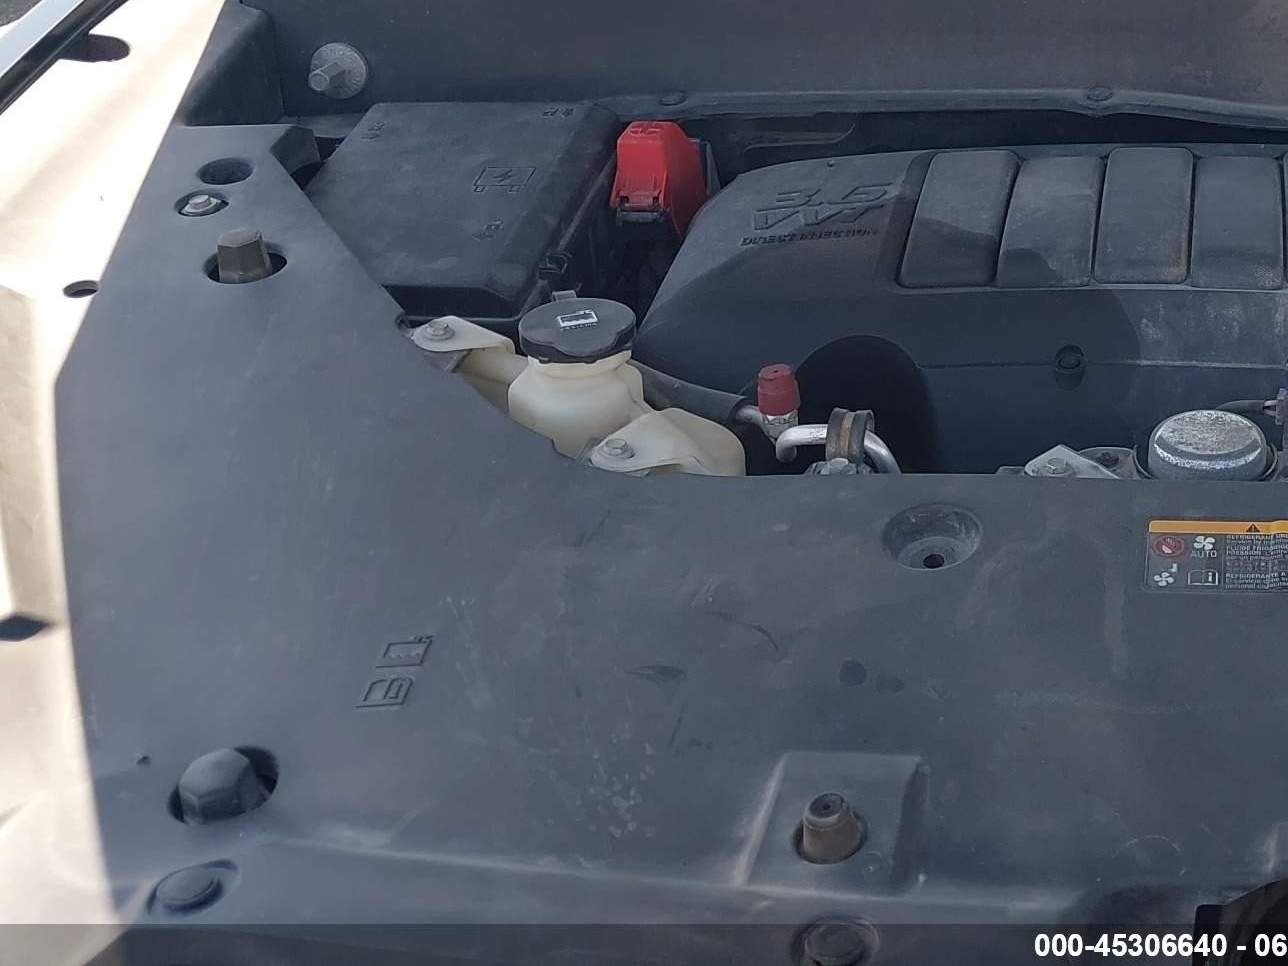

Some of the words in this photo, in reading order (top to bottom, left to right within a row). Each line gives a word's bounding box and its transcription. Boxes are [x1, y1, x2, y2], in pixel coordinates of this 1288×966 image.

[740, 231, 796, 247] DIRECT
[799, 226, 878, 242] INJECTION
[1190, 550, 1218, 558] AUTO
